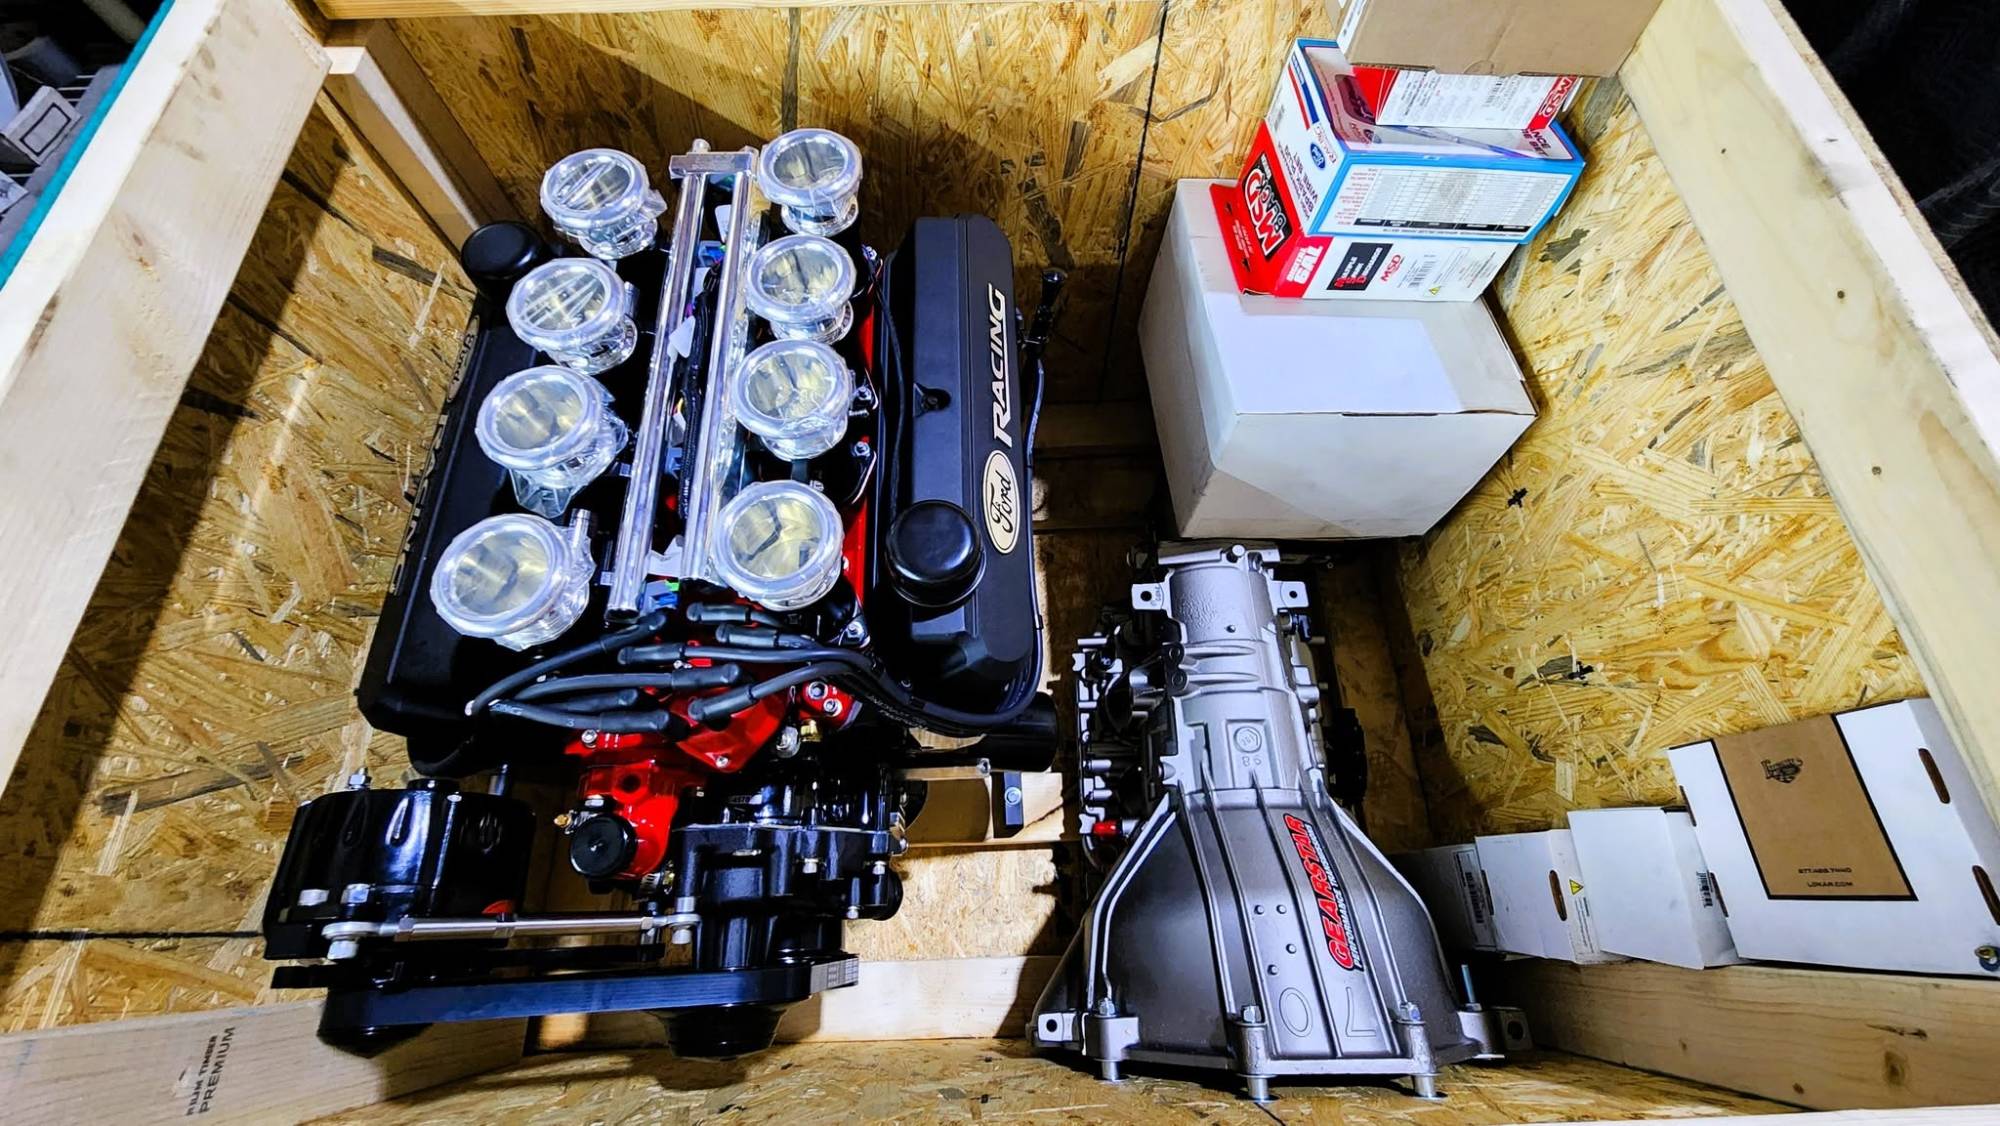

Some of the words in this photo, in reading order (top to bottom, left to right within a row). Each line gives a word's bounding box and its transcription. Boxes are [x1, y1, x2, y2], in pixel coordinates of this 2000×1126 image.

[1542, 76, 1572, 117] MSD
[1310, 146, 1325, 168] Ford
[1245, 168, 1285, 257] MSD
[1257, 175, 1287, 233] BLACK
[1297, 172, 1314, 212] SPARK
[1304, 174, 1318, 205] WIRE
[1294, 245, 1324, 285] 6AL
[1380, 254, 1402, 283] MSD
[987, 282, 1013, 448] RACING
[989, 470, 1013, 534] Ford
[1284, 814, 1354, 970] GEARSTAR
[1333, 887, 1363, 969] PERFORMANCE
[198, 1035, 218, 1076] TIMBER
[198, 1026, 236, 1114] PREMIUM
